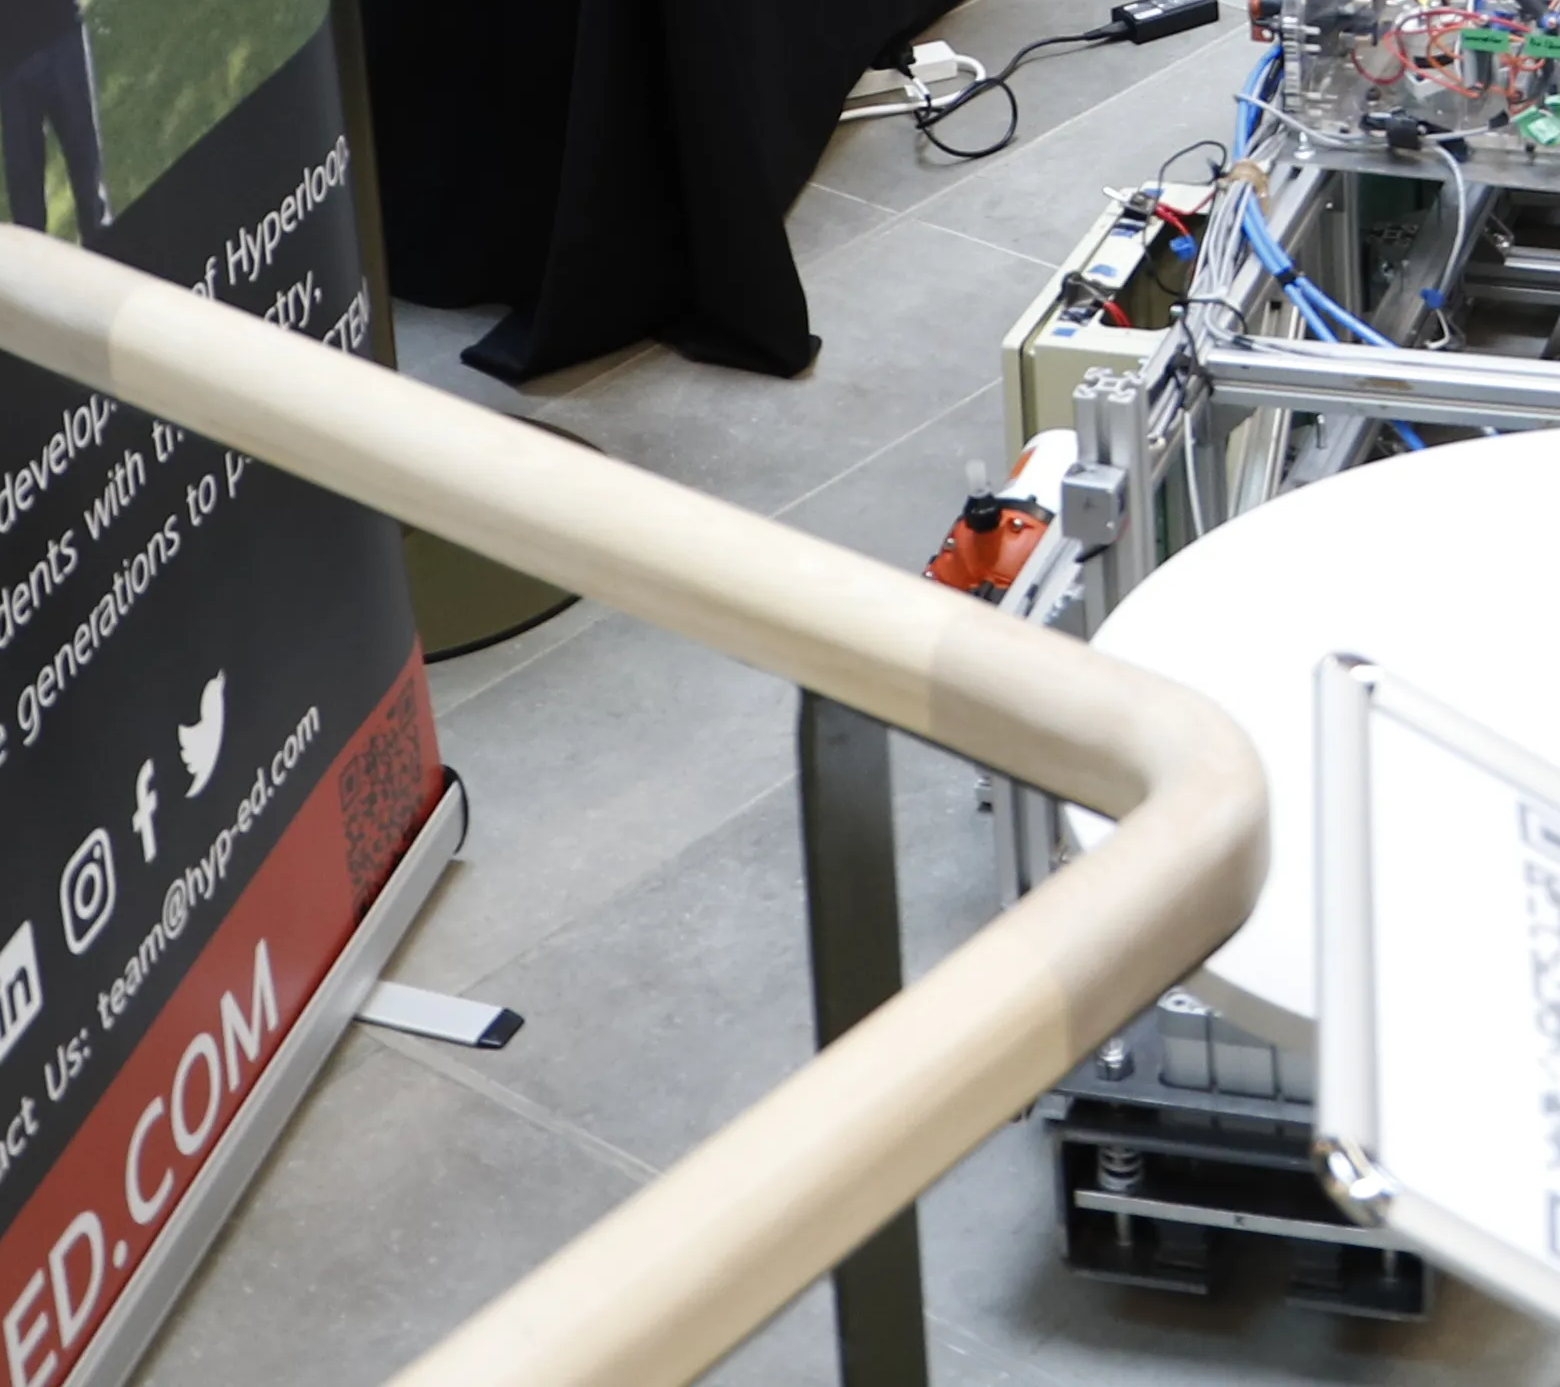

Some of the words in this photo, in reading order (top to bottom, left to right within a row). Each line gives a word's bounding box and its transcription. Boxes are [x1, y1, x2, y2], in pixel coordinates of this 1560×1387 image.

[17, 513, 182, 747] generations
[186, 472, 218, 528] to
[83, 449, 147, 542] with
[42, 1024, 94, 1104] Us:
[96, 703, 321, 1032] team@hyp-ed.com
